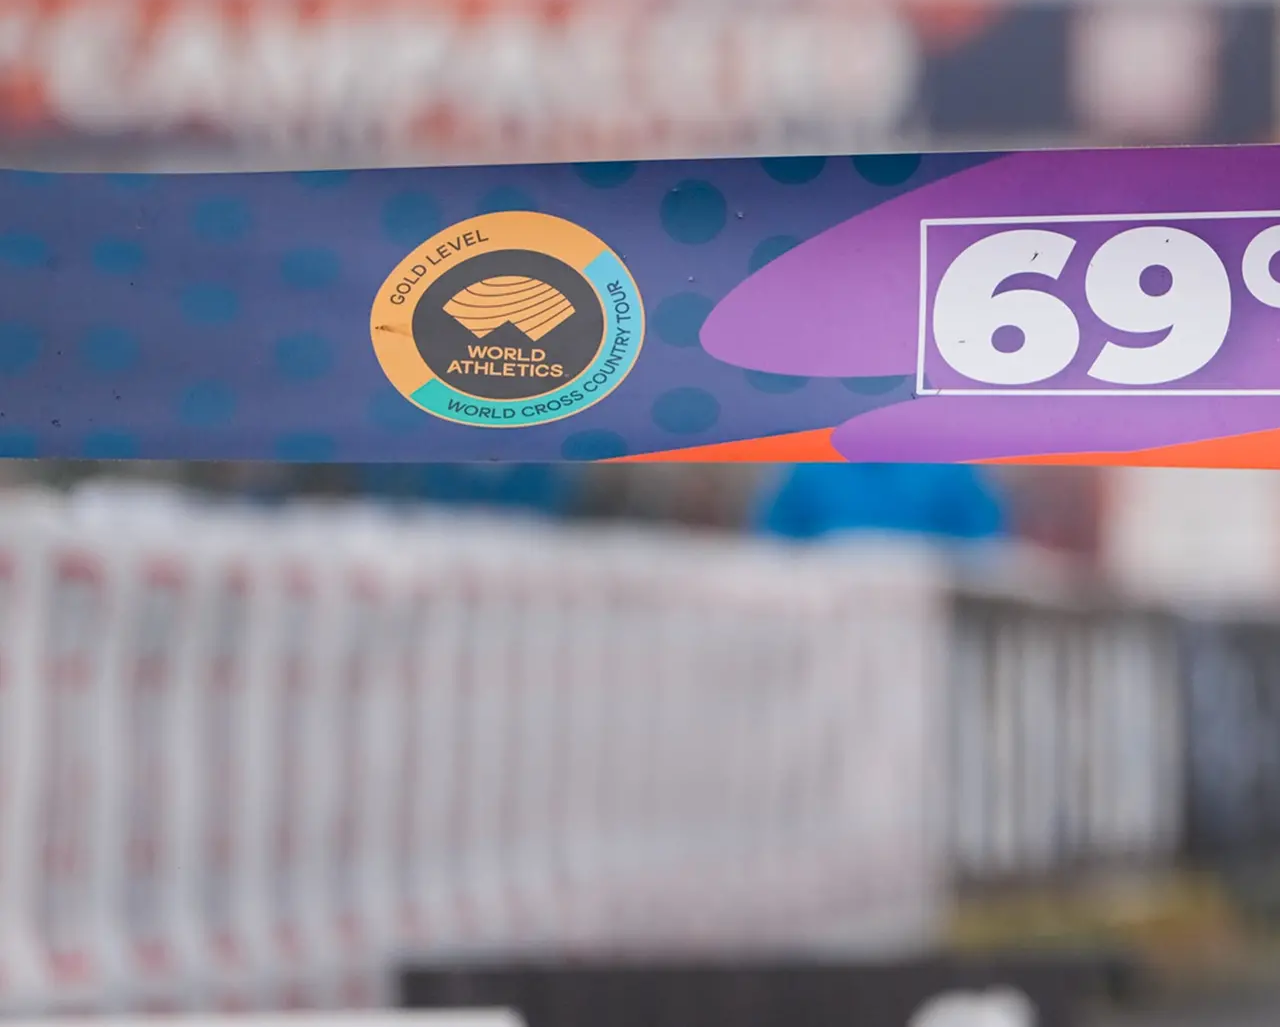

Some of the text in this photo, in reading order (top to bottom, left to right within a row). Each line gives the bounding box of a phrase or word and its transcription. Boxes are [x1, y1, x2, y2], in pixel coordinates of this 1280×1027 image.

[390, 228, 489, 306] GOLD LEVEL
[446, 344, 564, 378] WORLD ATHLETICS
[447, 279, 632, 419] WORLD CROSS COUNTRY TOUR
